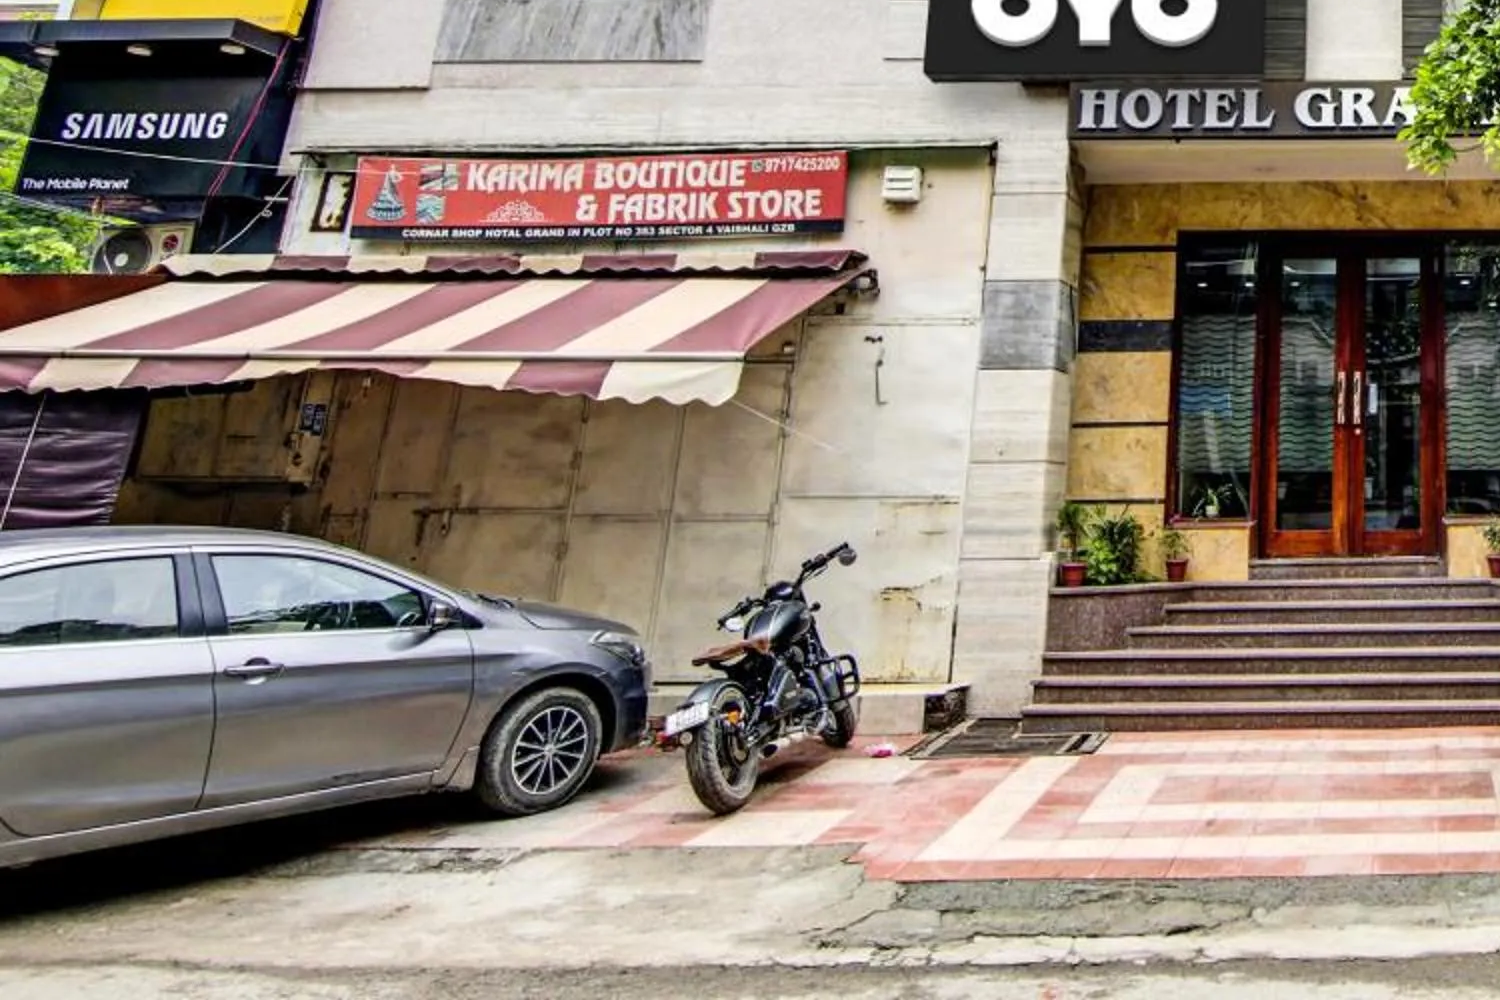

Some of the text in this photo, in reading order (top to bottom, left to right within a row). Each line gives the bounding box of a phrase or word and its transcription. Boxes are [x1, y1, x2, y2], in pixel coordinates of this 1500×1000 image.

[1077, 88, 1276, 130] HOTEL
[61, 112, 229, 140] SAMSUNG
[23, 177, 129, 190] The Mobile Planet
[466, 158, 747, 194] KARIMA BOUTIQUE
[576, 189, 824, 225] & FABRIK STORE
[451, 228, 483, 238] SHOP
[524, 227, 565, 238] GRAND
[583, 226, 613, 237] PLOT
[615, 226, 633, 237] NO
[657, 224, 703, 236] SECTOR
